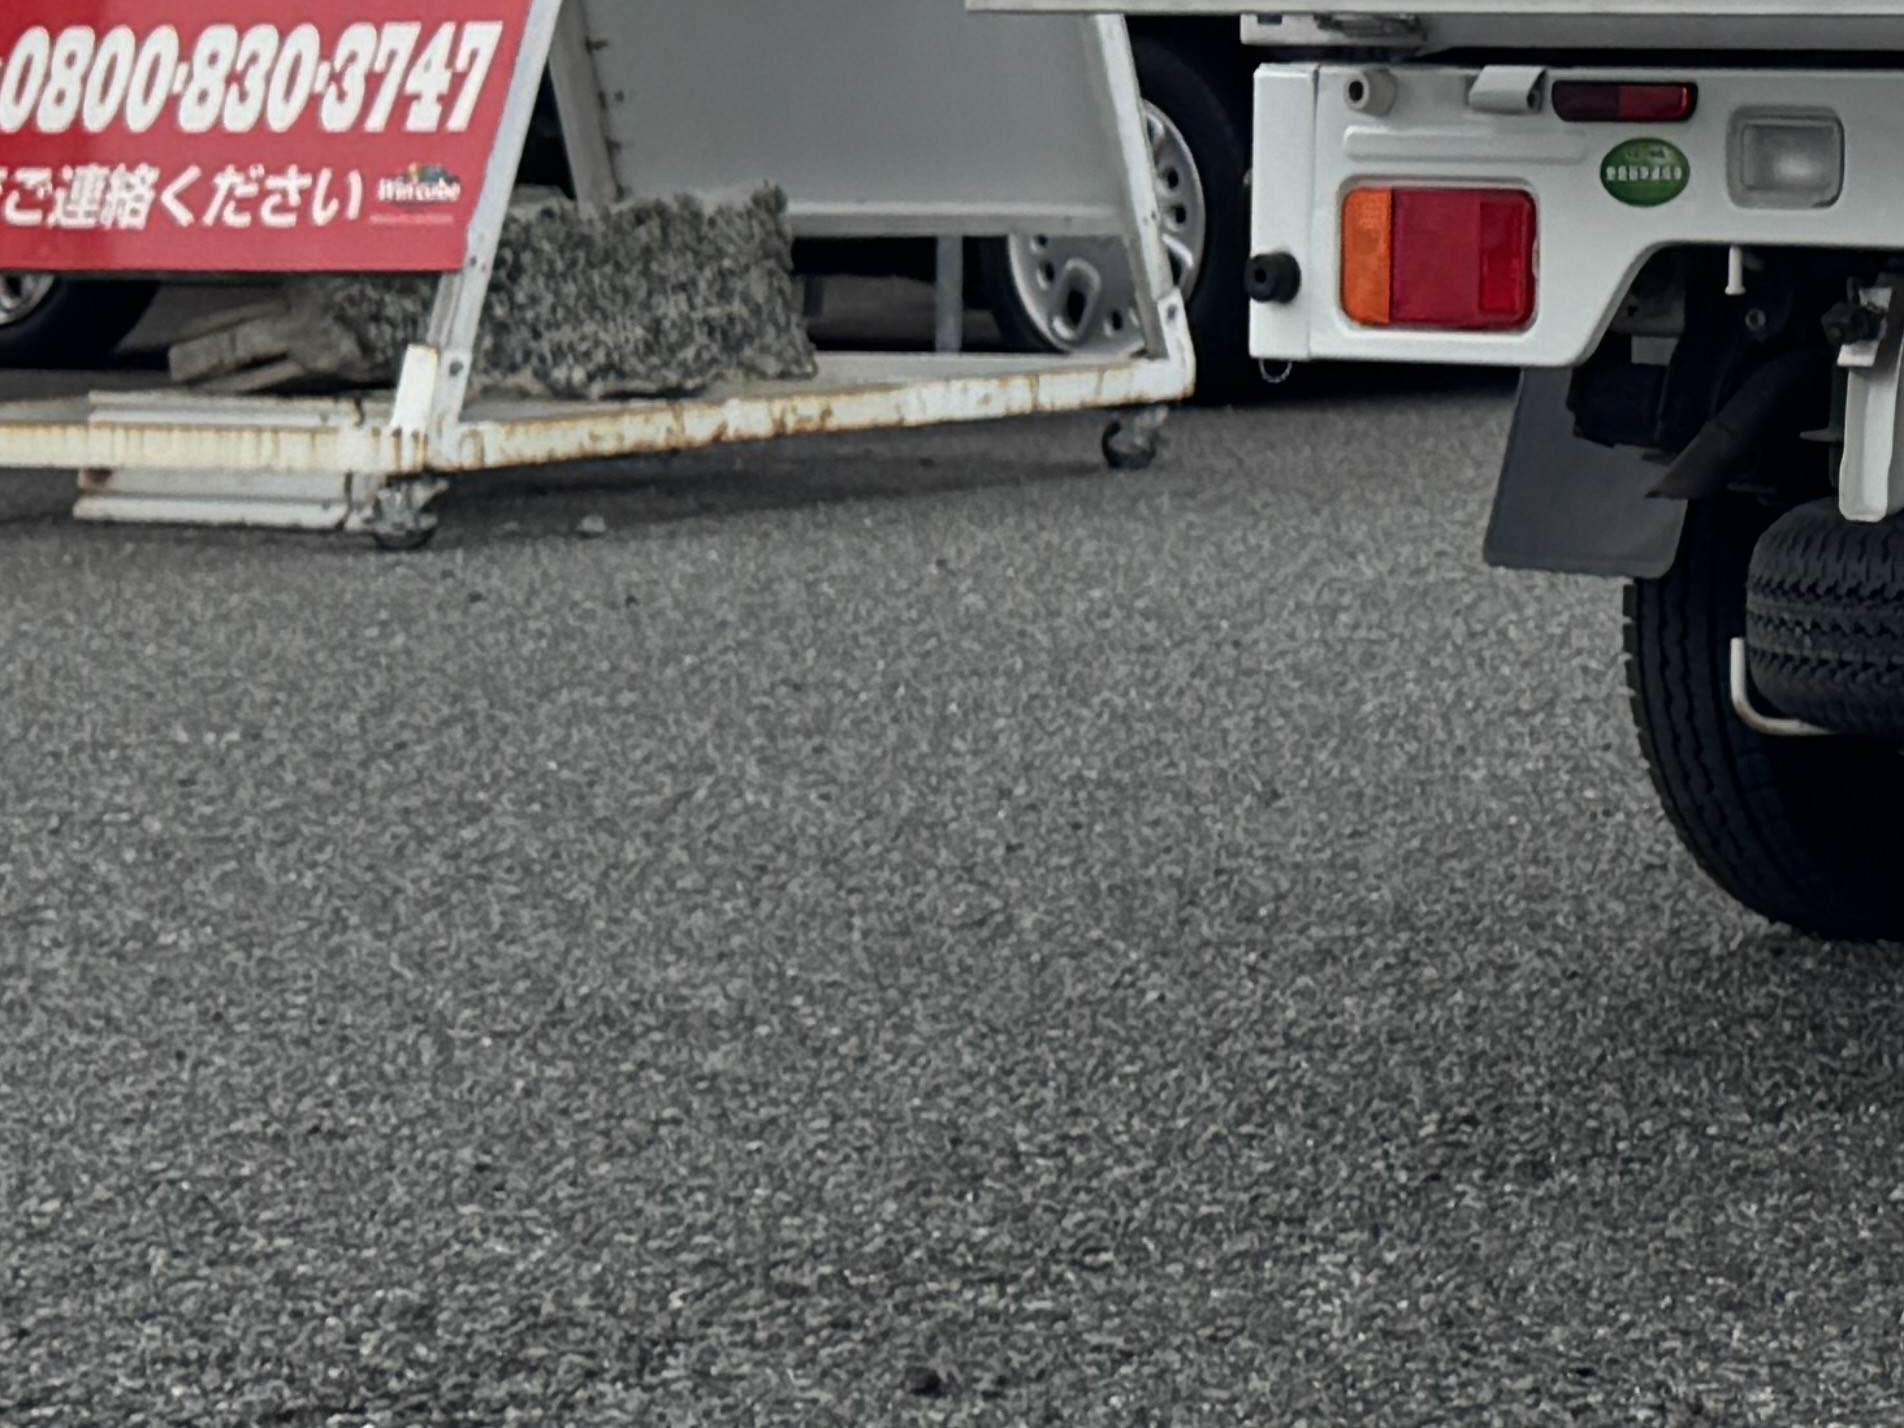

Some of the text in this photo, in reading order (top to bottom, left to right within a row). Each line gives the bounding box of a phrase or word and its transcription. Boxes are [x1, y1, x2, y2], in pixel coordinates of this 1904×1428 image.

[0, 163, 363, 231] ご連絡ください
